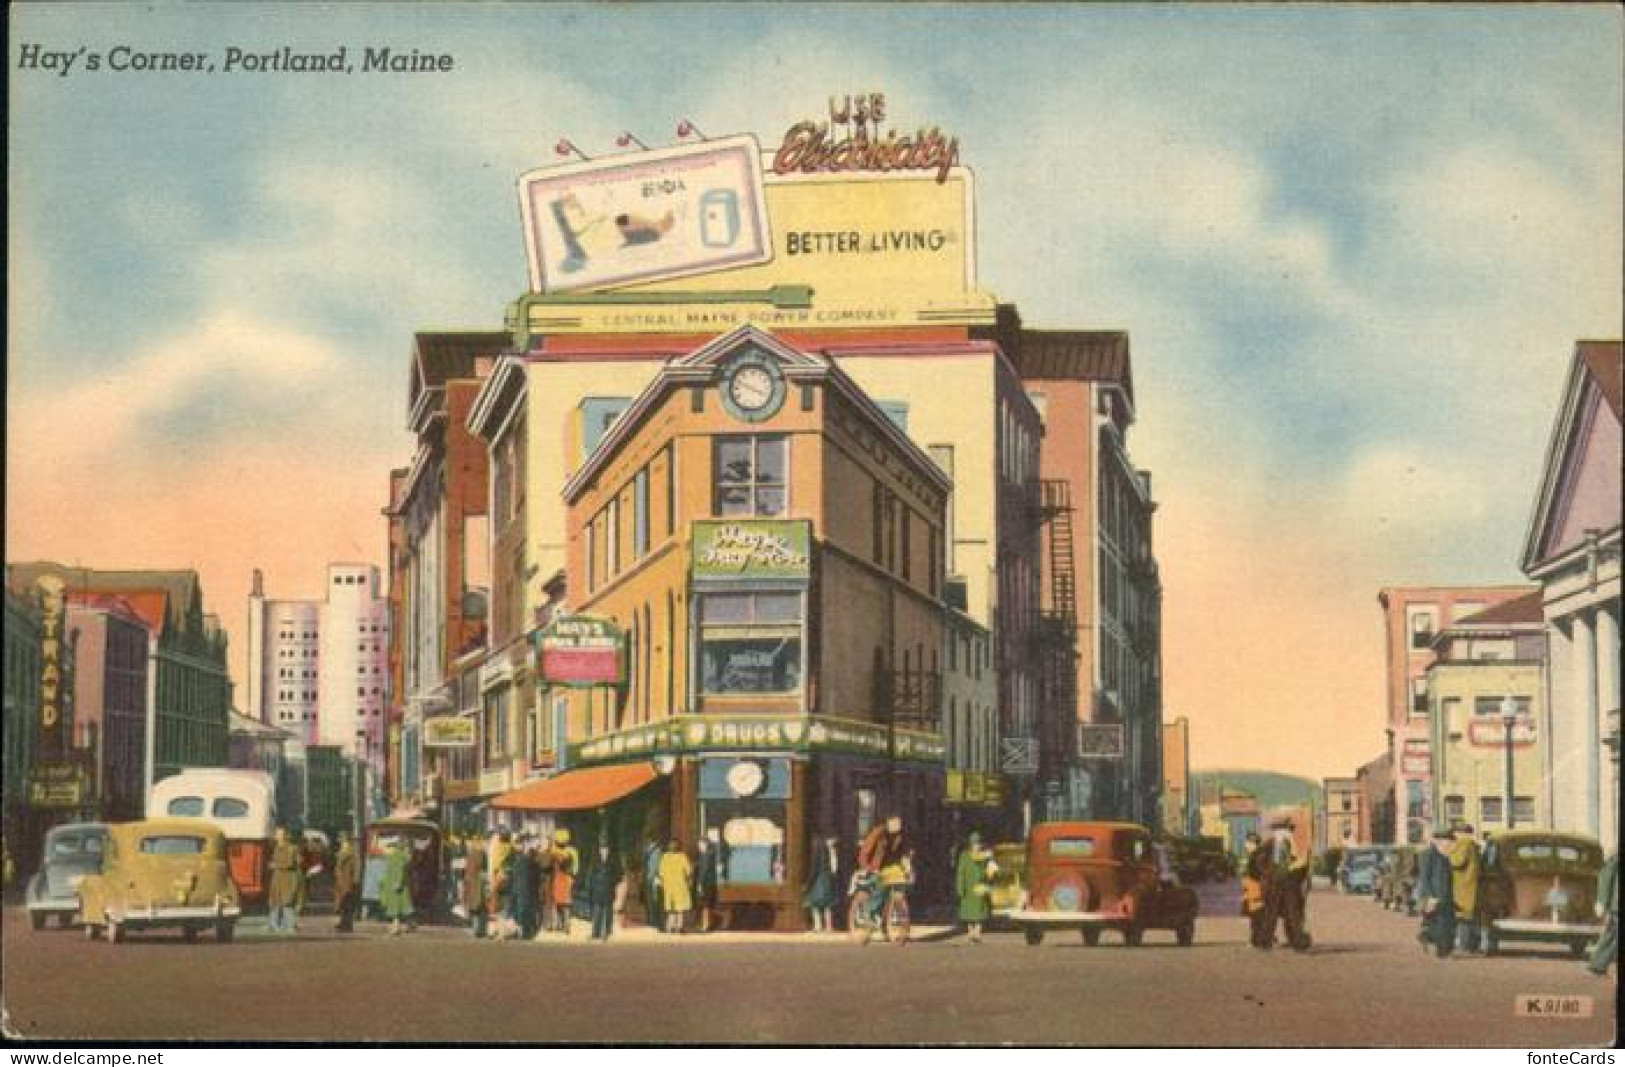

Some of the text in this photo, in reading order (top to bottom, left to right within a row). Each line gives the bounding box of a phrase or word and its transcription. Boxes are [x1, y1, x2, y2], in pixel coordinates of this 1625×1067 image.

[786, 230, 946, 255] BETTER LIVING
[686, 312, 738, 323] MAINE
[749, 310, 810, 323] POWER
[816, 310, 897, 321] COMPANY
[711, 722, 781, 745] DRUGS
